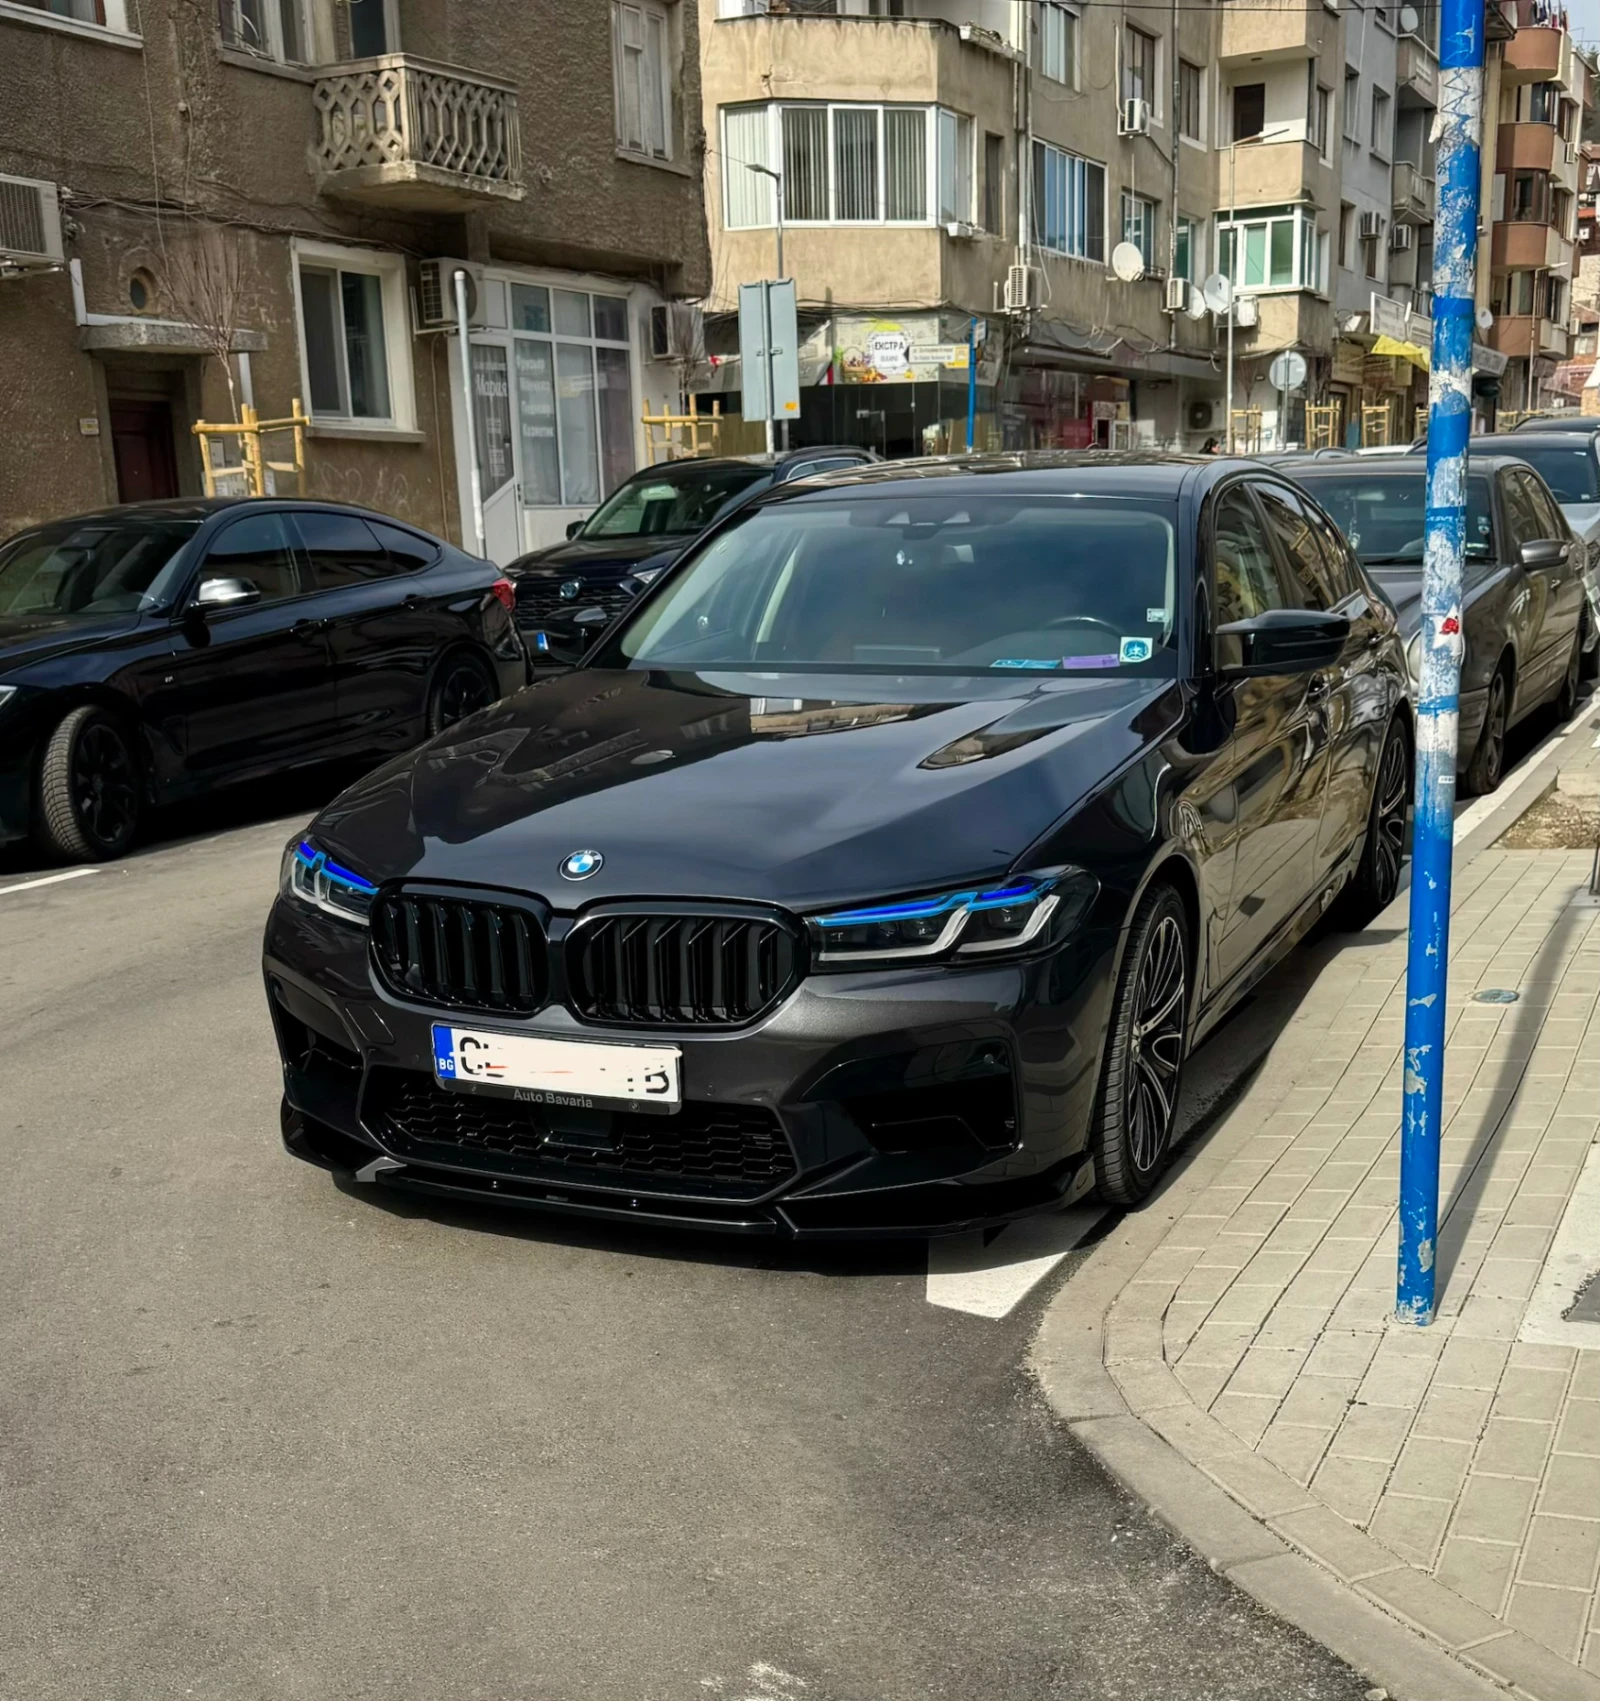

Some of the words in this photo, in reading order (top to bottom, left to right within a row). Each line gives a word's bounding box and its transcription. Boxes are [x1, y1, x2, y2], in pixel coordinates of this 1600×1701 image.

[874, 341, 904, 351] ЕКСТРА
[475, 373, 508, 397] Мария
[438, 1057, 455, 1071] BG
[513, 1089, 544, 1103] Auto
[546, 1092, 593, 1108] Bavaria
